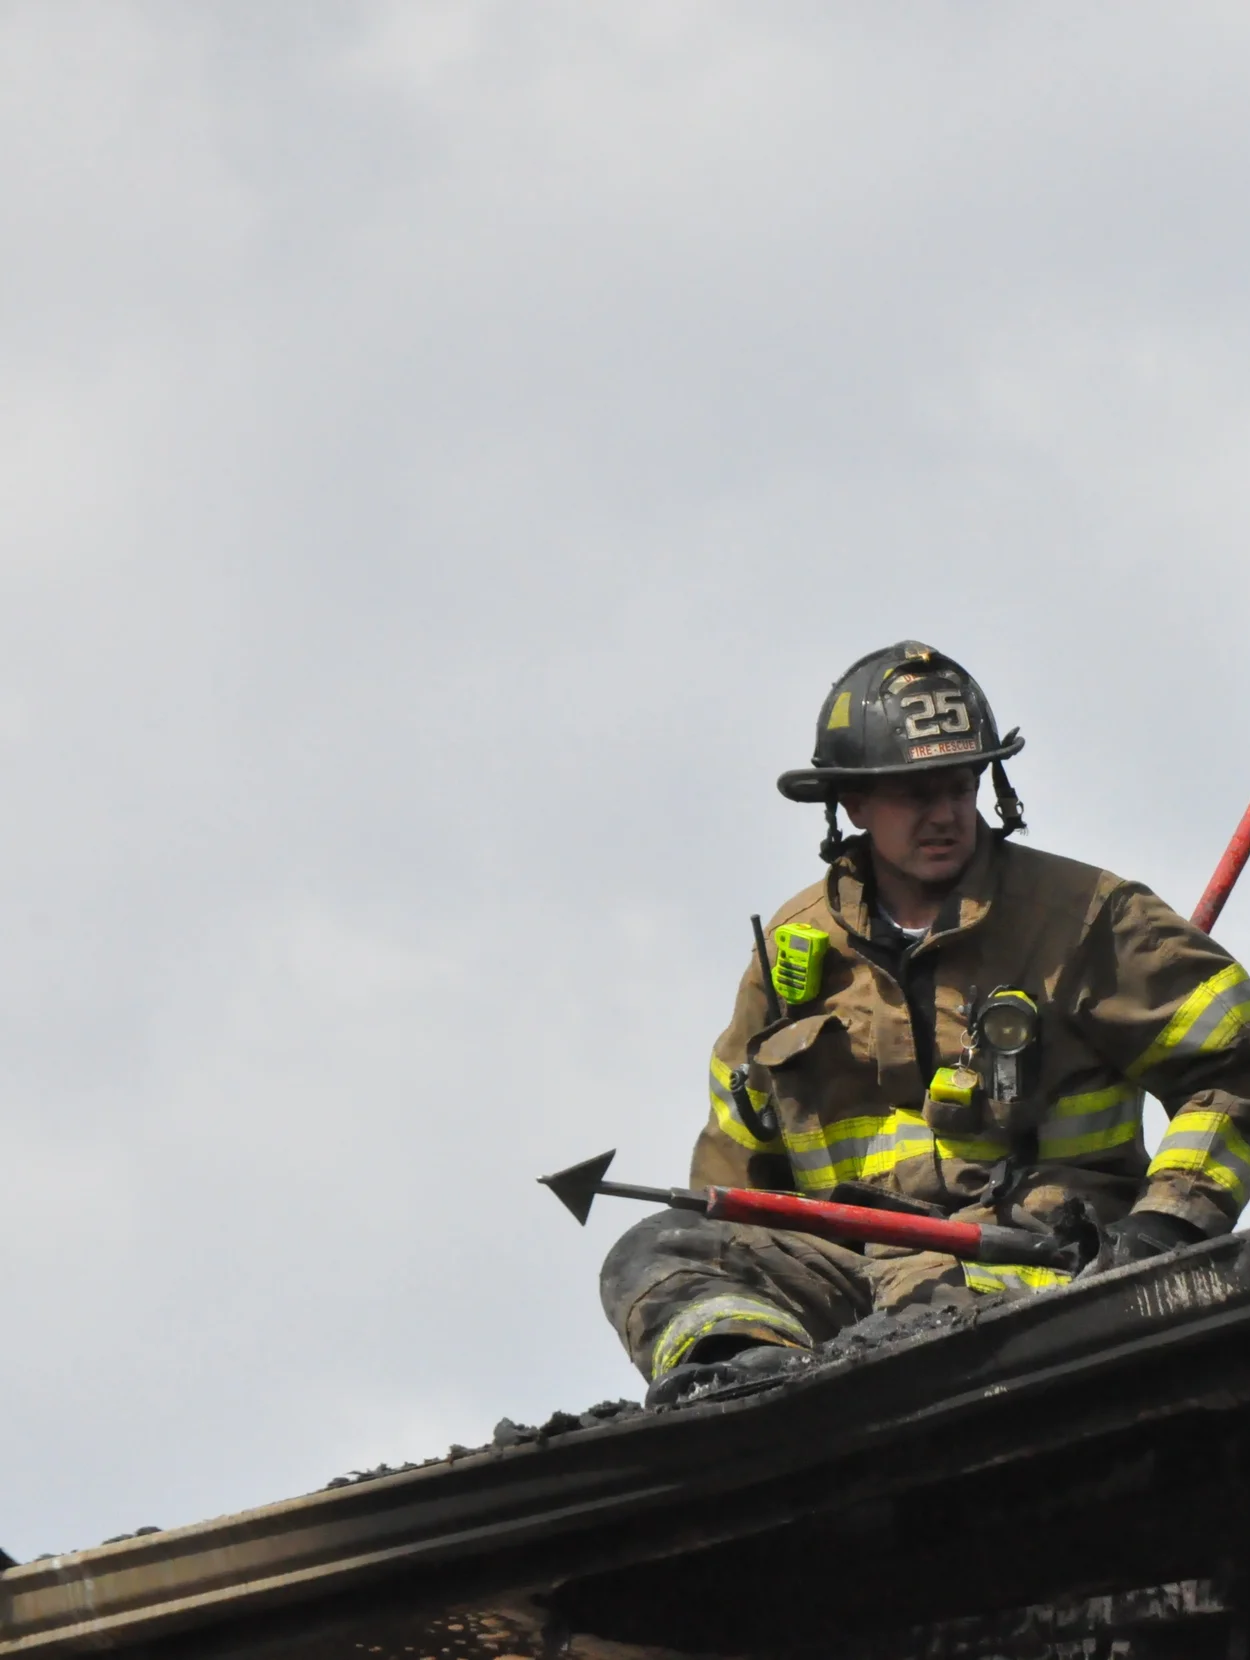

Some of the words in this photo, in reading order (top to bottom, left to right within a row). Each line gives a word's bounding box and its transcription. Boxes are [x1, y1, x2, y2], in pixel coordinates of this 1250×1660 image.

[901, 690, 970, 739] 25
[909, 744, 932, 758] FIRE
[939, 741, 975, 752] RESCUE
